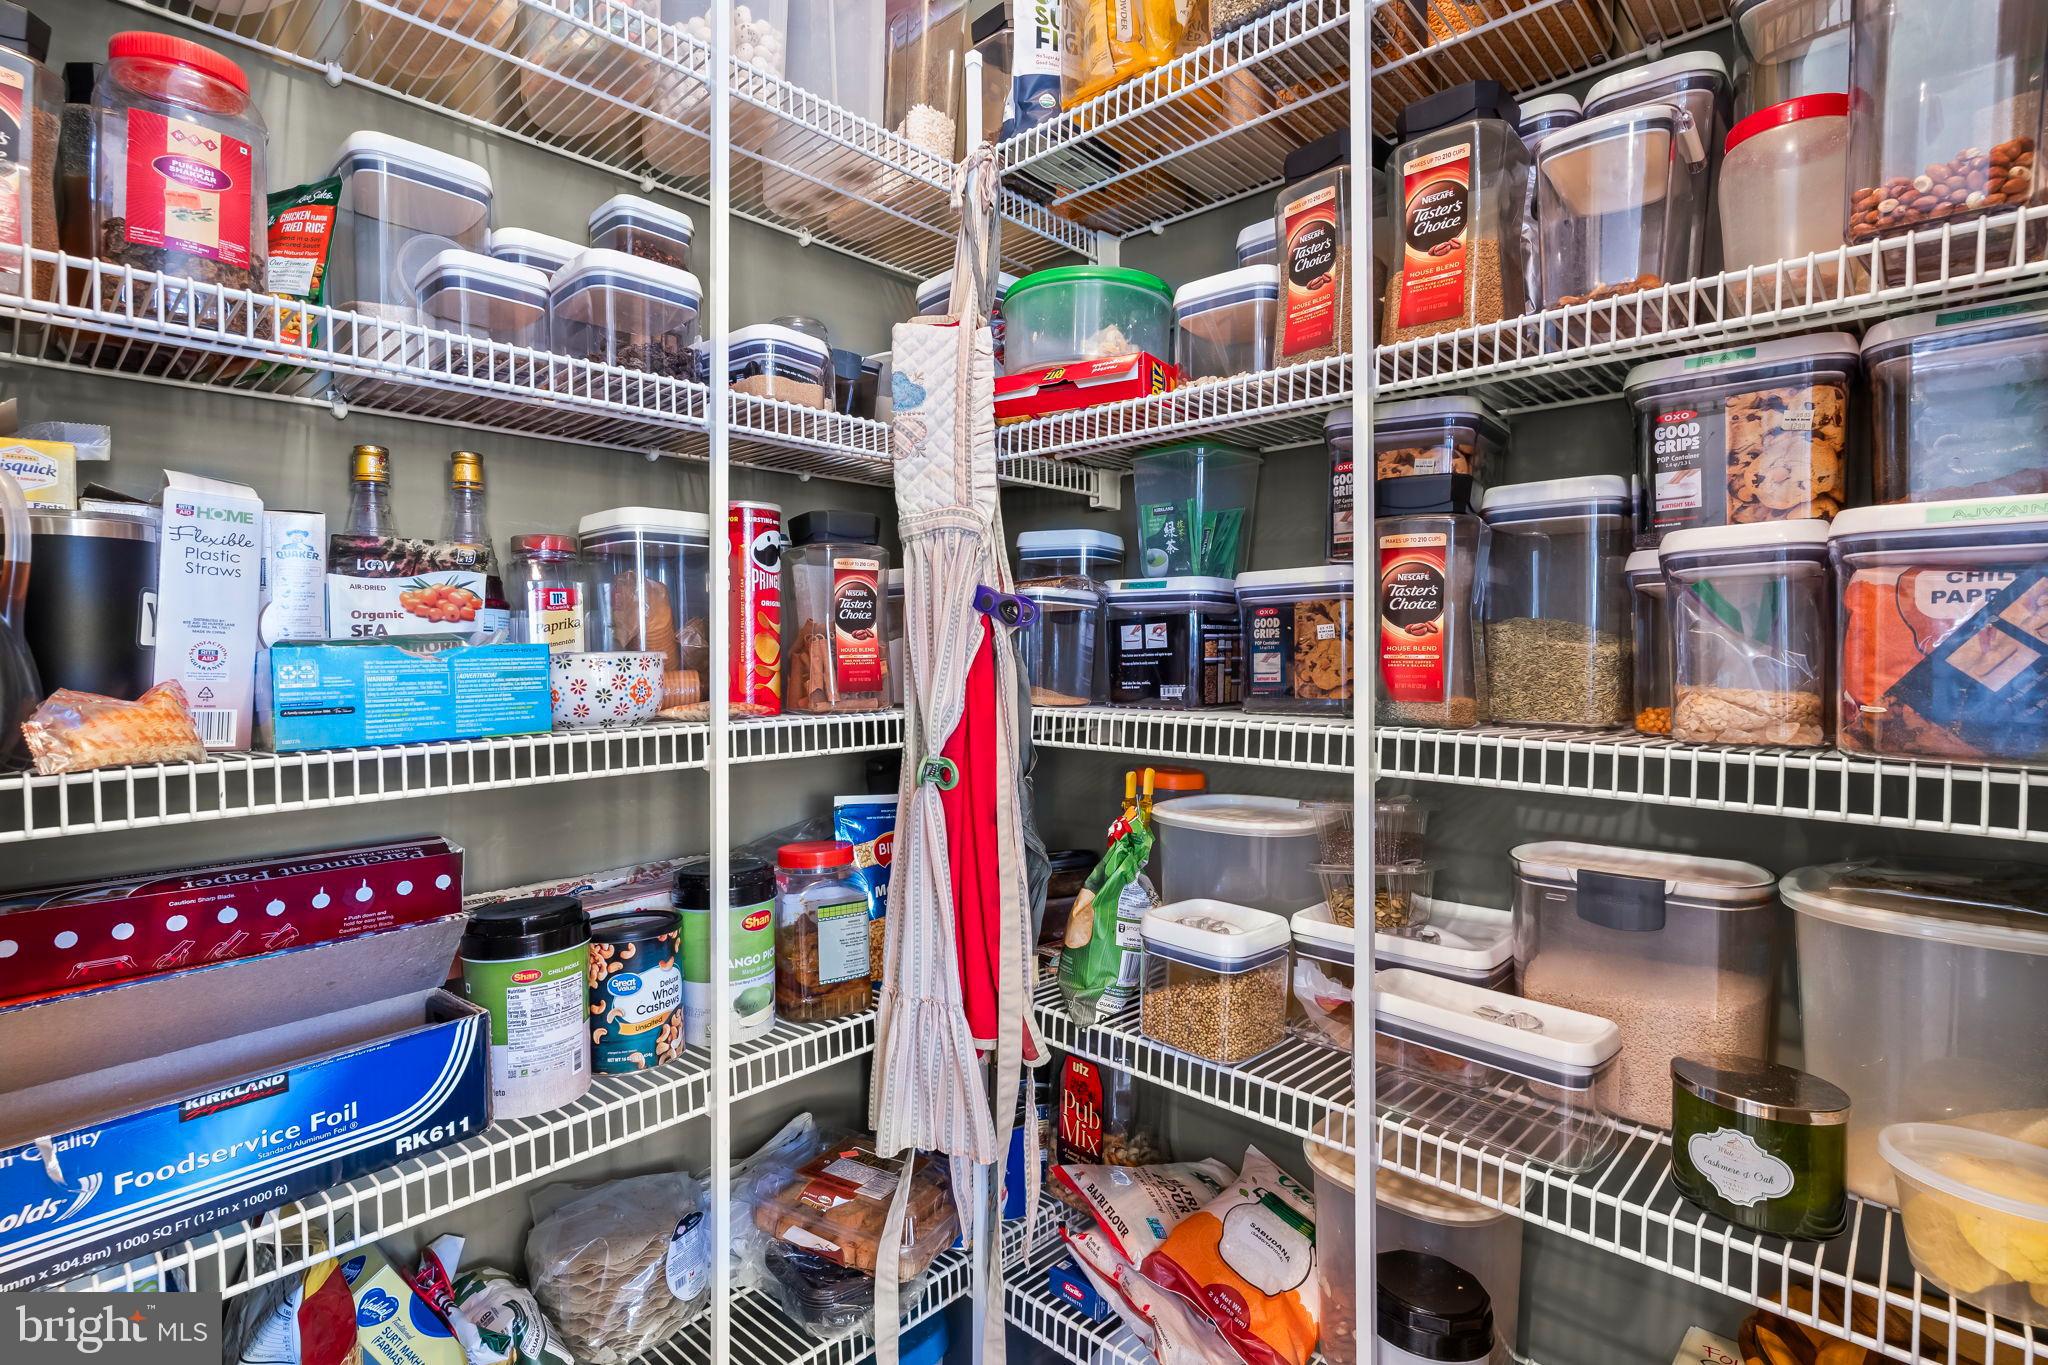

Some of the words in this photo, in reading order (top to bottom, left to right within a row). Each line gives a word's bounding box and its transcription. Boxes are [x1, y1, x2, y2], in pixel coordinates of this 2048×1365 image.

[1409, 160, 1427, 170] MAKES
[1427, 158, 1434, 166] UP
[1442, 151, 1452, 160] 210
[1452, 148, 1466, 157] CUPS
[169, 165, 217, 184] SHAKKAR
[172, 159, 215, 177] PUNJABI
[280, 210, 311, 223] CHICKEN
[1413, 200, 1463, 224] Taster's
[281, 222, 303, 233] FRIED
[305, 222, 326, 233] RICE
[1413, 216, 1461, 237] Choice
[1293, 237, 1332, 261] Taster's
[1294, 252, 1331, 273] Choice
[1409, 268, 1434, 278] HOUSE
[1436, 261, 1460, 273] BLEND
[1292, 301, 1312, 311] HOUSE
[1313, 294, 1331, 305] BLEND
[1664, 412, 1690, 422] OXO
[1654, 423, 1700, 441] GOOD
[1654, 436, 1701, 455] GRIPS
[1656, 456, 1670, 464] POP
[1671, 453, 1700, 462] Container
[0, 459, 57, 478] isquick
[1333, 473, 1353, 486] GOO
[1661, 502, 1684, 510] AIRTIGHT
[197, 506, 254, 525] HOME
[168, 525, 255, 548] Flexible
[185, 546, 241, 563] Plastic
[276, 550, 320, 560] QUAKER
[185, 561, 241, 578] Straws
[1946, 571, 2017, 584] CHIL
[349, 583, 387, 591] AIR-DRIED
[752, 568, 781, 592] PRINGL
[1388, 583, 1439, 597] Taster's
[839, 597, 873, 609] Taster's
[1389, 598, 1436, 611] Choice
[351, 610, 404, 621] Organic
[839, 608, 872, 620] Choice
[351, 624, 389, 637] SEA
[536, 618, 581, 635] Paprika
[1254, 618, 1280, 629] GOOD
[1253, 628, 1280, 639] GRIPS
[188, 640, 229, 657] SATISFACTION
[278, 850, 425, 875] Parchment
[180, 867, 271, 890] Paper
[168, 898, 197, 907] Caution:
[197, 896, 217, 904] Sharp
[744, 913, 770, 928] Shan
[728, 954, 761, 969] ANGO
[513, 973, 539, 982] Shan
[548, 966, 564, 976] CHILI
[612, 978, 637, 987] Great
[660, 975, 679, 988] Deluxe
[652, 984, 679, 1000] Whole
[636, 994, 680, 1015] Cashews
[635, 1016, 663, 1032] Unsalted
[185, 1074, 285, 1111] KIRKLAND
[185, 1086, 286, 1120] Signature
[1064, 1089, 1100, 1130] Pub
[257, 1143, 292, 1160] Standard
[293, 1131, 332, 1149] Aluminum
[333, 1125, 348, 1135] Foil
[395, 1116, 469, 1156] RK611
[1061, 1114, 1100, 1157] Mix
[21, 1131, 102, 1162] Qality
[114, 1122, 301, 1196] Foodservice
[310, 1101, 358, 1132] Foil
[1703, 1154, 1740, 1176] Cashmere
[1753, 1172, 1775, 1185] Oak
[0, 1199, 61, 1233] olds
[1086, 1183, 1109, 1210] BAJRI
[1104, 1205, 1130, 1239] FLOUR
[38, 1269, 49, 1280] x
[52, 1246, 112, 1277] 304.8m)
[116, 1232, 150, 1252] 1000
[152, 1225, 173, 1242] SQ
[175, 1217, 192, 1233] FT
[194, 1205, 215, 1227] (12
[217, 1203, 230, 1216] in
[231, 1203, 240, 1212] x
[242, 1189, 273, 1209] 1000
[274, 1184, 288, 1198] ft)
[1250, 1222, 1291, 1263] SABUDANA
[1064, 1282, 1083, 1298] Barilla
[360, 1295, 394, 1323] Vadilal
[1219, 1291, 1232, 1305] Net
[1231, 1301, 1243, 1315] Wt.
[381, 1326, 403, 1348] SURTI
